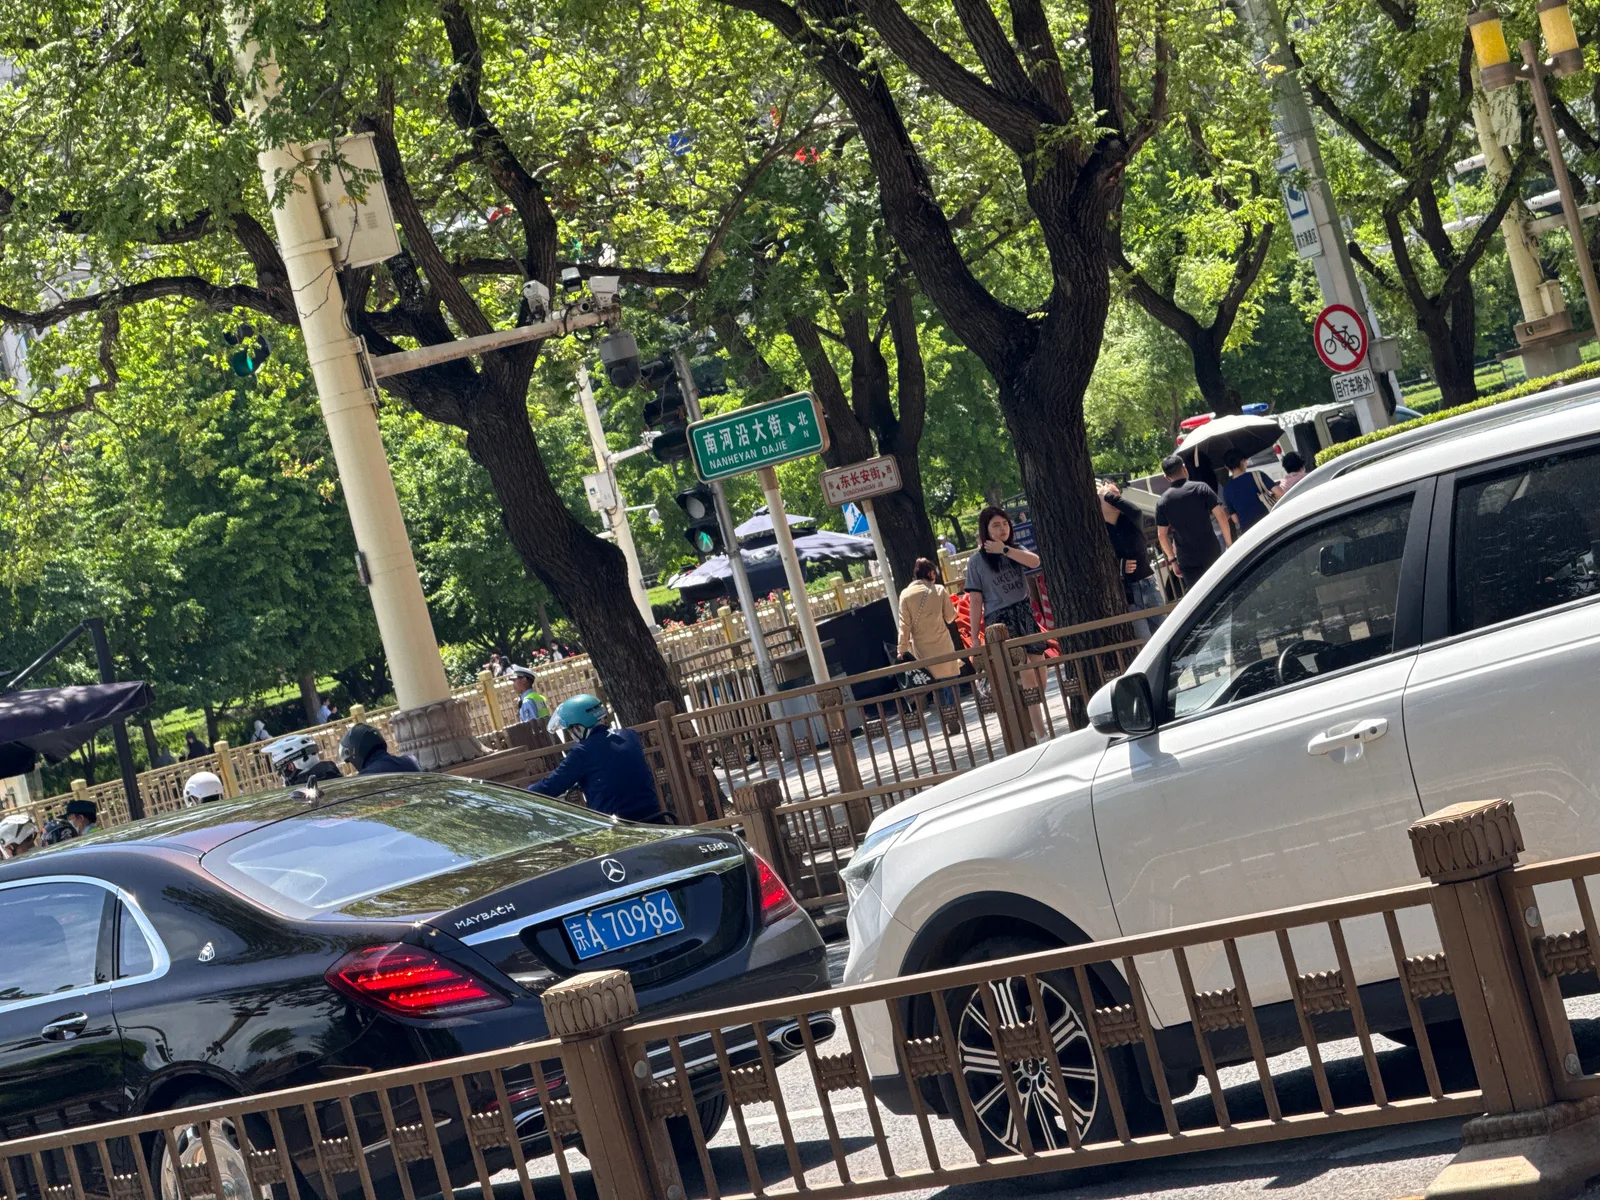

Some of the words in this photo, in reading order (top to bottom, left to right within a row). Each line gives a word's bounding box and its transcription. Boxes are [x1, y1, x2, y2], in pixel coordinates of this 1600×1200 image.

[1335, 375, 1371, 398] 自行车除外
[798, 411, 808, 425] 北
[703, 414, 782, 455] 南河沿大街
[709, 448, 757, 470] NANHEYAN
[761, 440, 788, 456] DAJIE
[840, 467, 880, 488] 东长安街
[454, 904, 516, 930] MAYBACH
